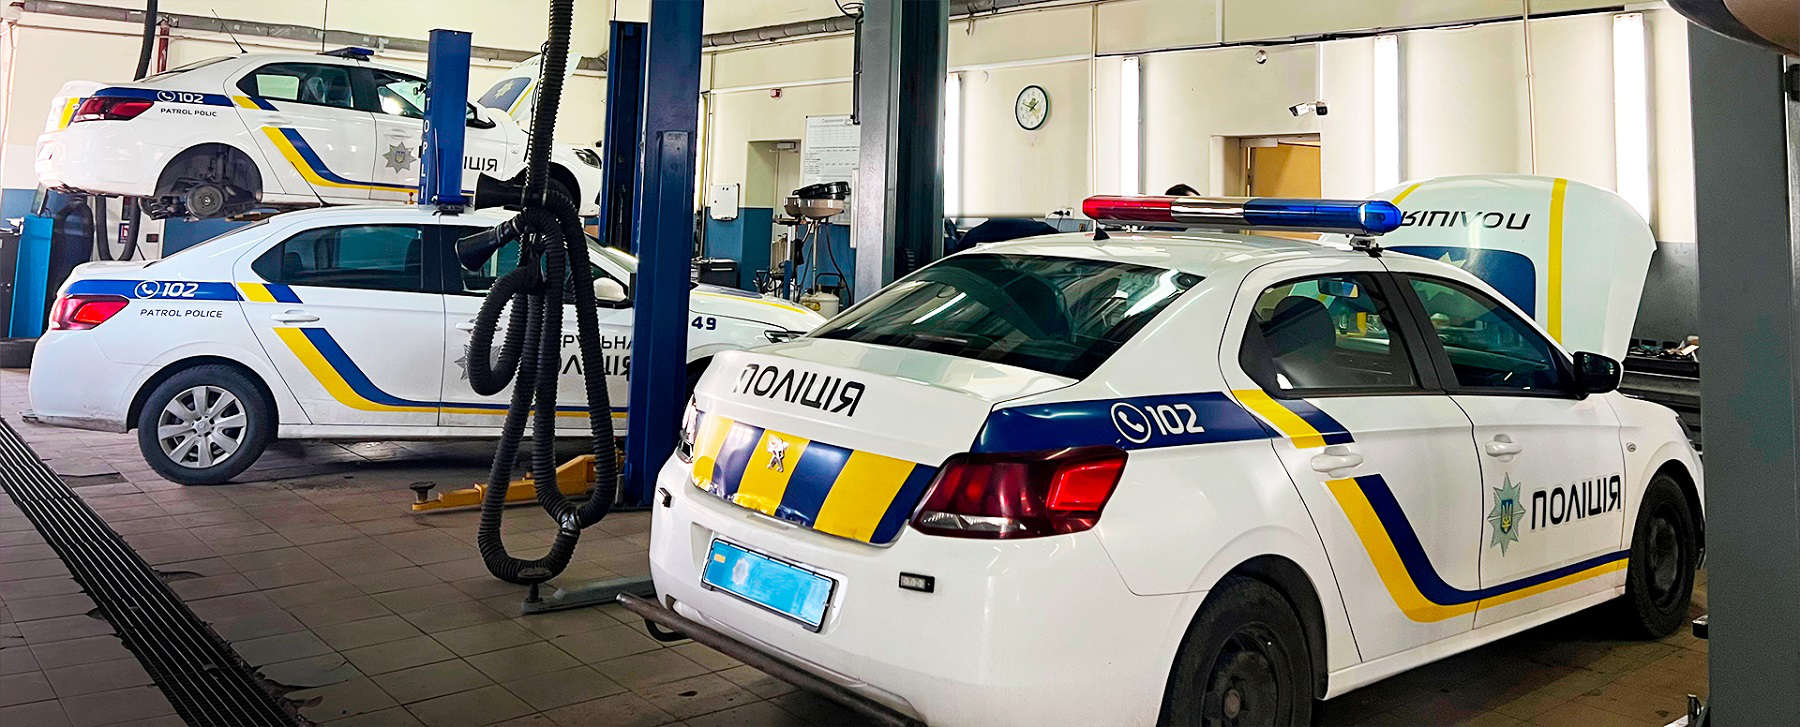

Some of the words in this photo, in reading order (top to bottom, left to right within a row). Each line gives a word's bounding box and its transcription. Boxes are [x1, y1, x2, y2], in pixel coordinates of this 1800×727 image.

[178, 92, 204, 103] 102
[162, 282, 199, 297] 102
[140, 309, 182, 317] PATROL
[185, 310, 223, 318] POLICE
[734, 363, 866, 417] ПОЛІЦІЯ
[1144, 403, 1205, 436] 102
[1531, 475, 1621, 530] ПОЛІЦІЯ
